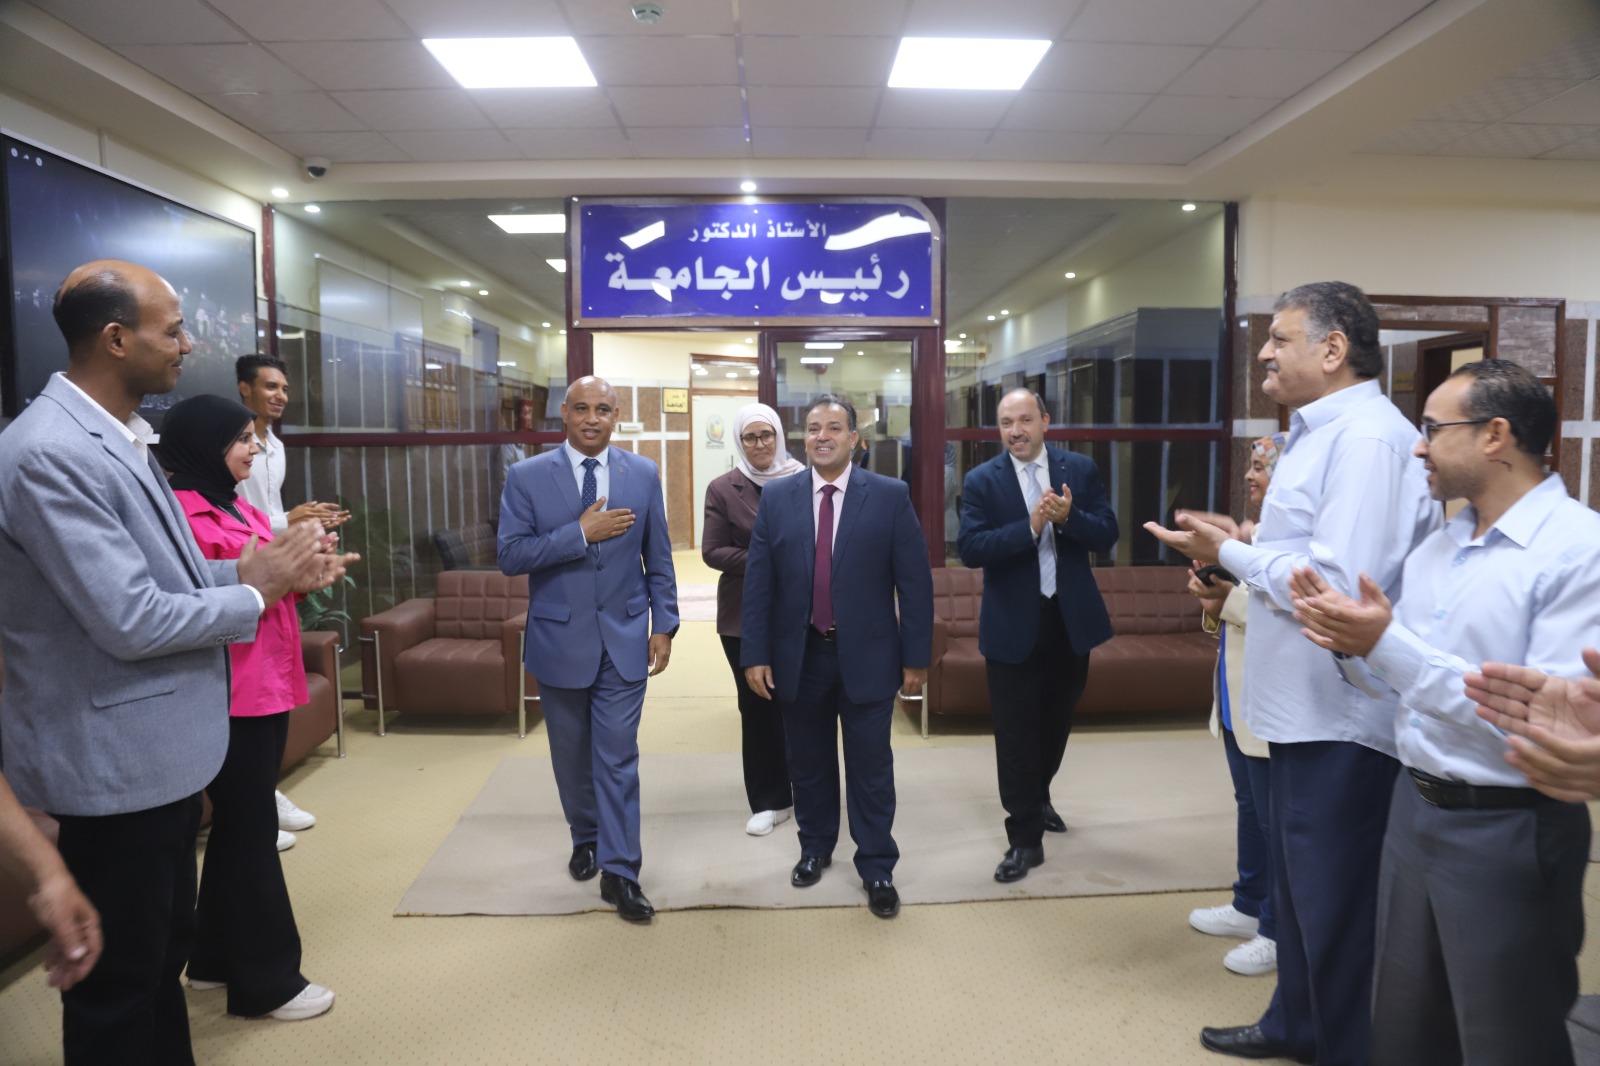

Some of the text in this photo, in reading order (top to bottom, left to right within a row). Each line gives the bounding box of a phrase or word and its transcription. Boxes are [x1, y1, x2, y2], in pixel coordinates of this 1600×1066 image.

[688, 221, 757, 243] الدكتور
[604, 252, 910, 301] رئيس الجامعة
